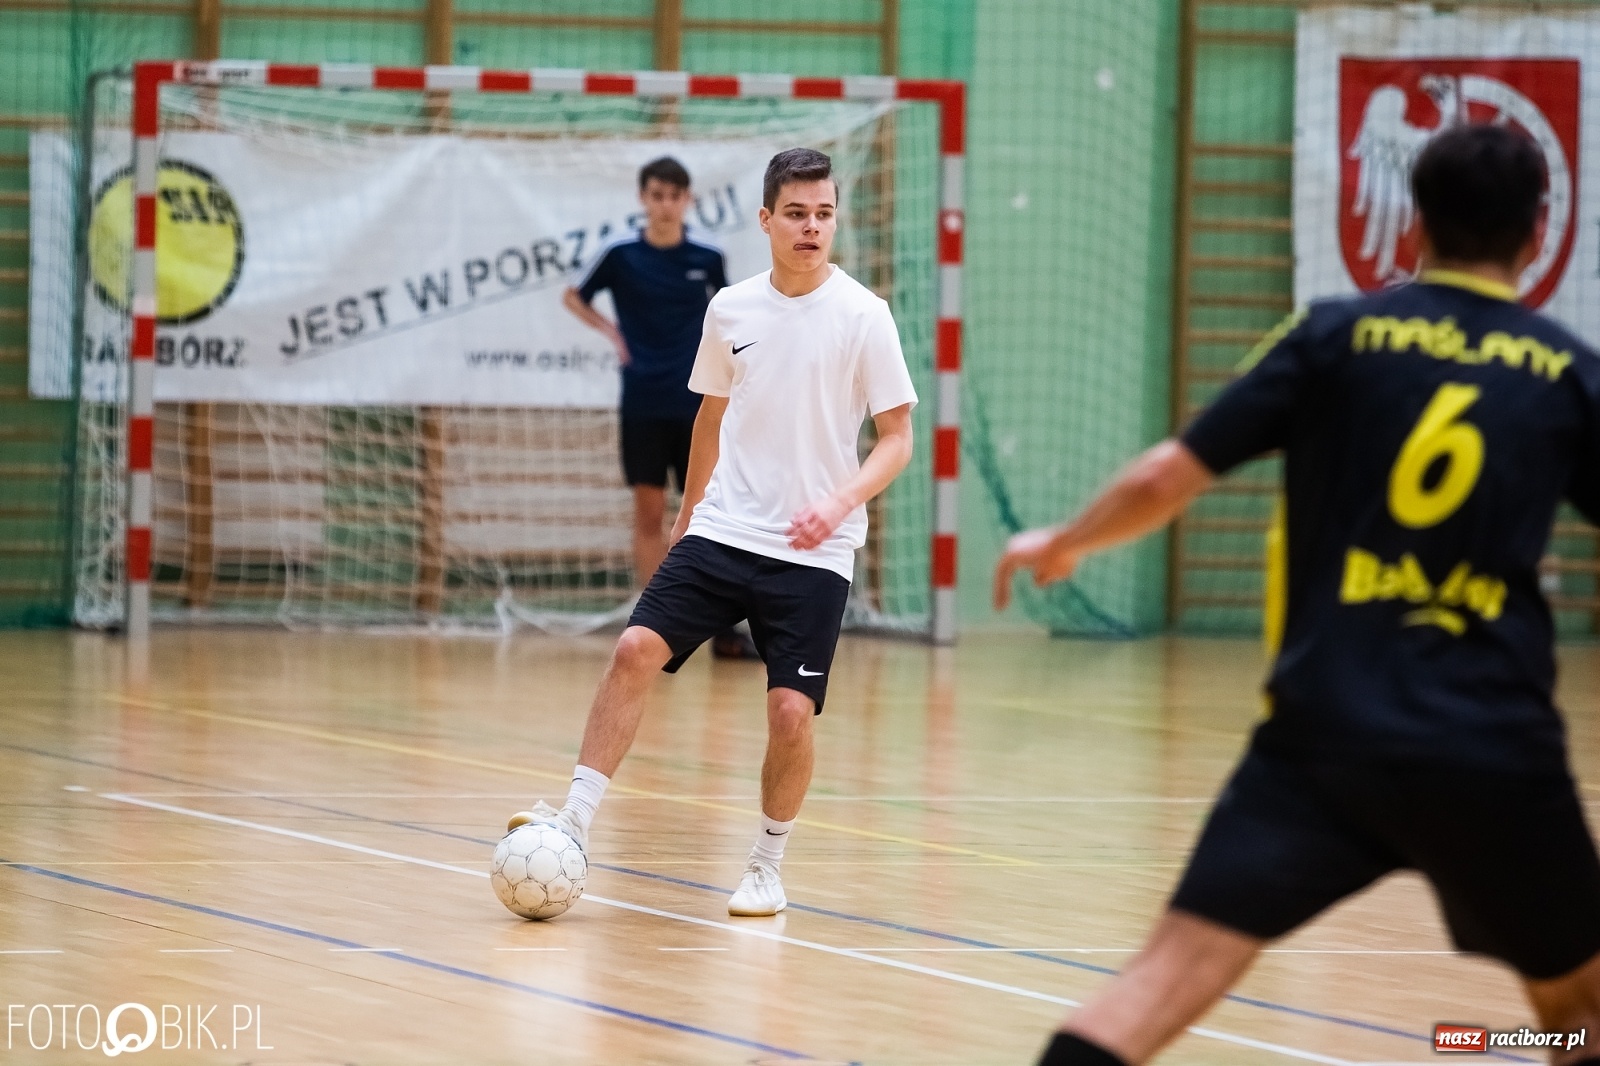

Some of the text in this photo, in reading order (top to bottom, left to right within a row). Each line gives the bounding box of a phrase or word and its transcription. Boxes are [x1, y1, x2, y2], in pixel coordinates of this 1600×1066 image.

[279, 182, 744, 356] JEST W PORZU!
[1387, 381, 1484, 529] 6
